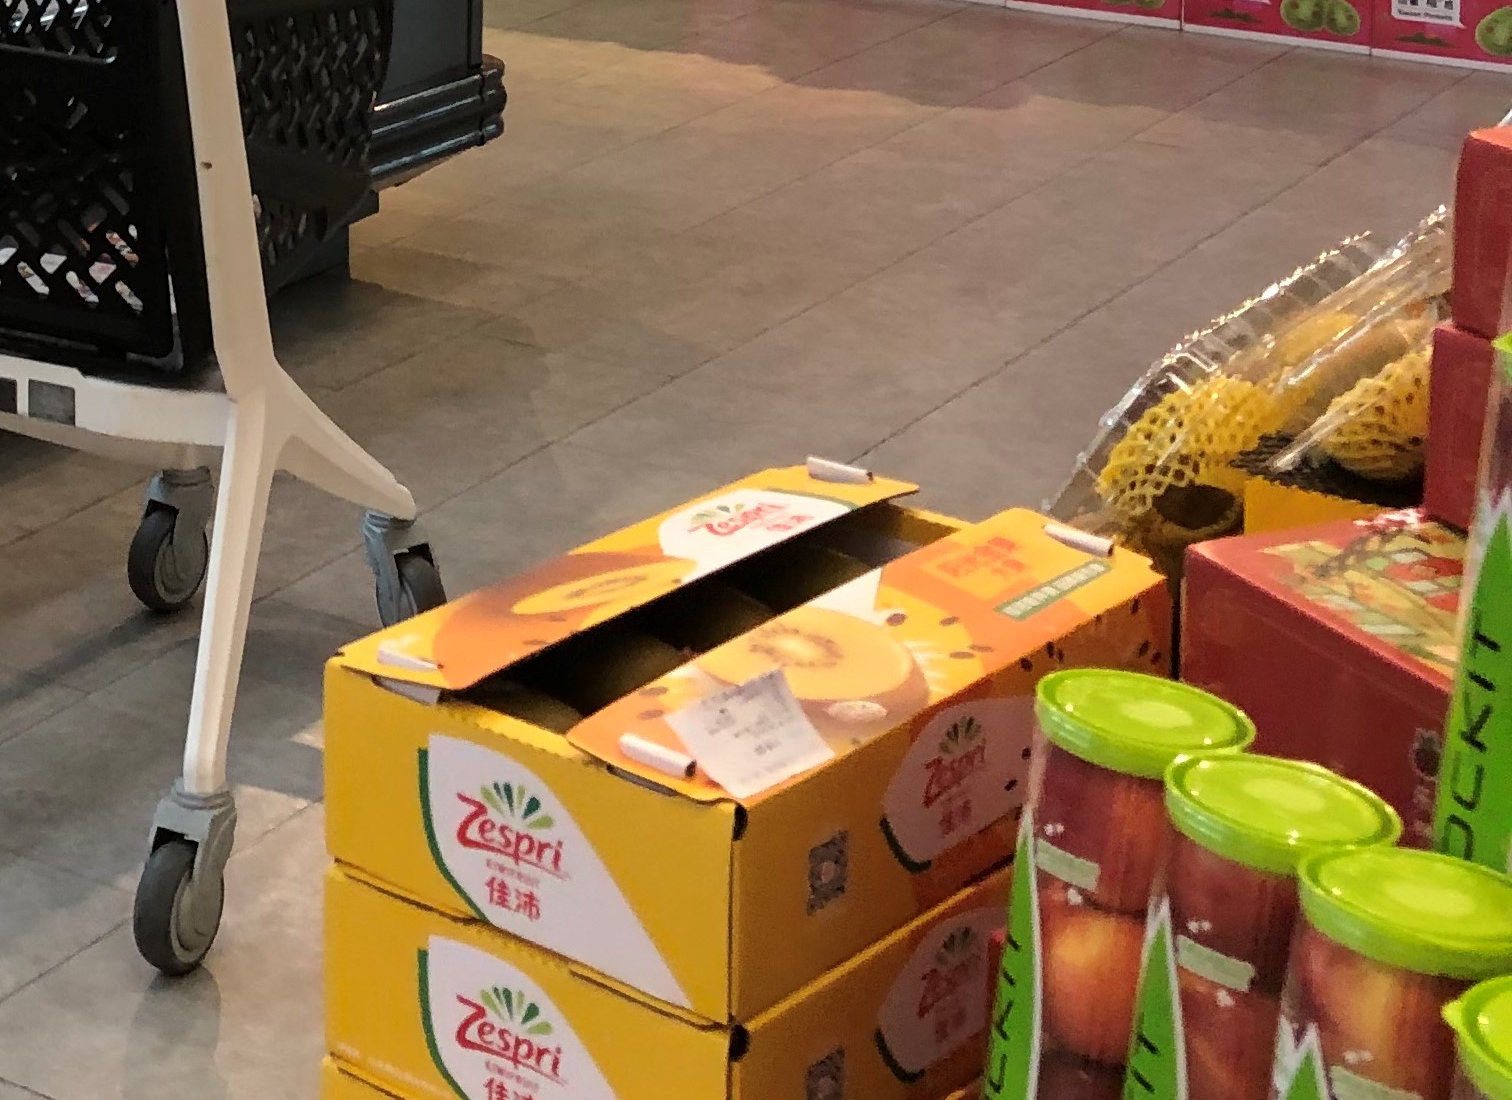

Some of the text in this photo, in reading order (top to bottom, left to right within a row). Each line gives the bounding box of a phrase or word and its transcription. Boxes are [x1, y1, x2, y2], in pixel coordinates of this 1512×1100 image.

[456, 792, 566, 876] Zespri
[484, 876, 541, 922] 佳沛
[455, 993, 563, 1079] Zespri
[484, 1077, 534, 1100] 佳
